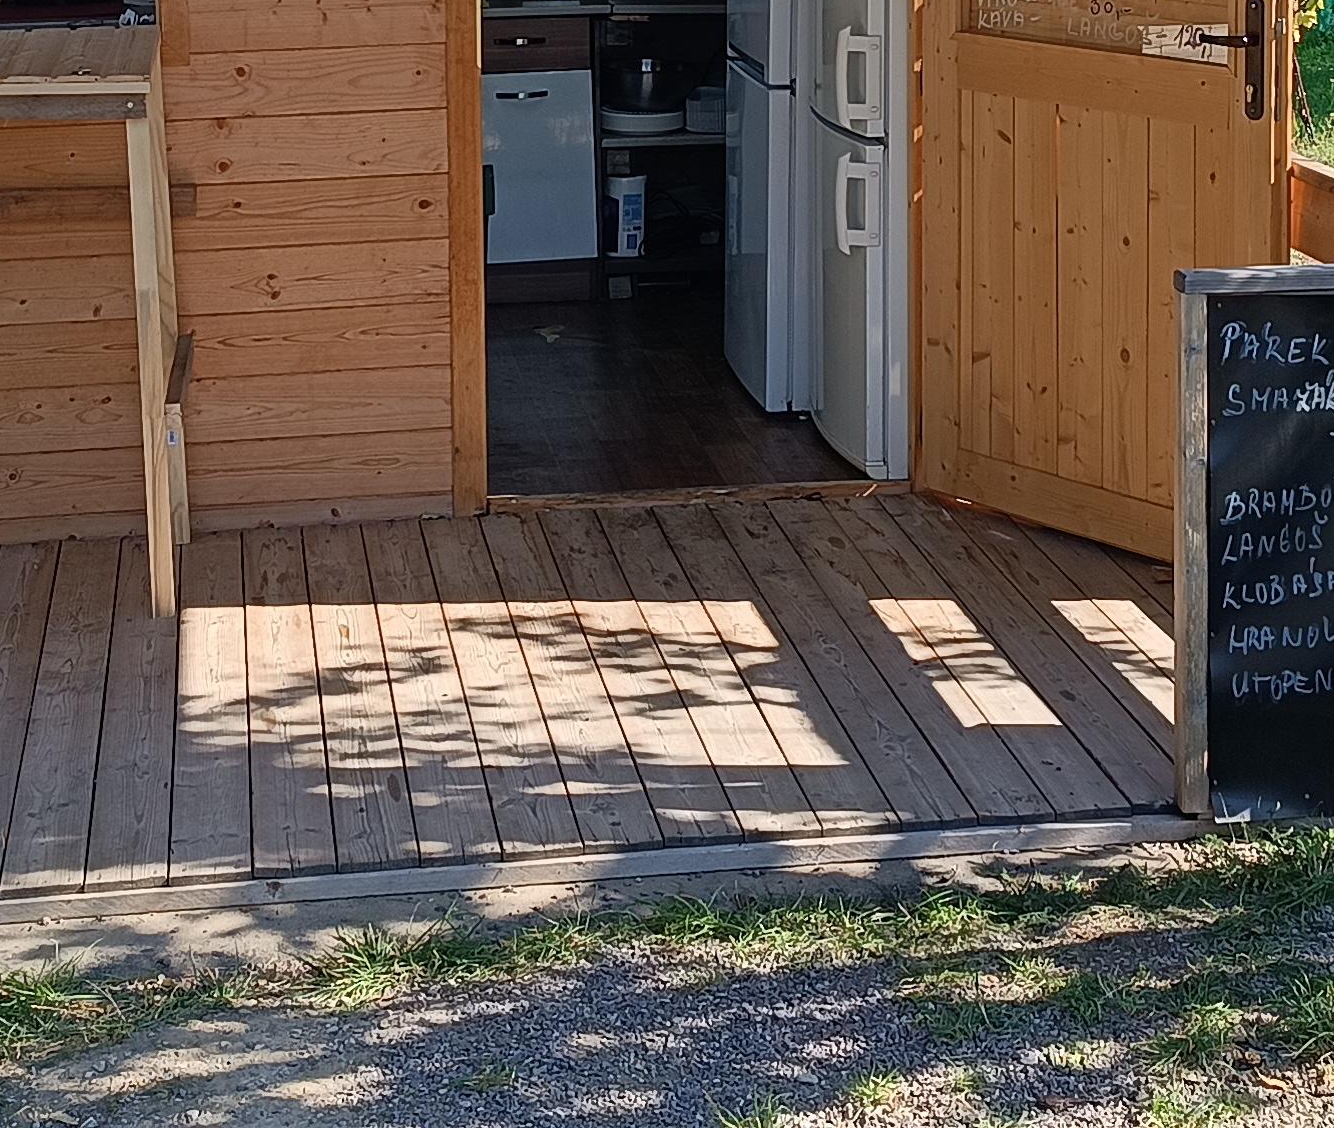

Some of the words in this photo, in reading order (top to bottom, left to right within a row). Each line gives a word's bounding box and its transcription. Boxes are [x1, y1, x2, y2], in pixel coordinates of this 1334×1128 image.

[977, 8, 1024, 29] KÁVA
[1220, 321, 1330, 365] PÁREK
[1221, 510, 1328, 565] LANGOŠ
